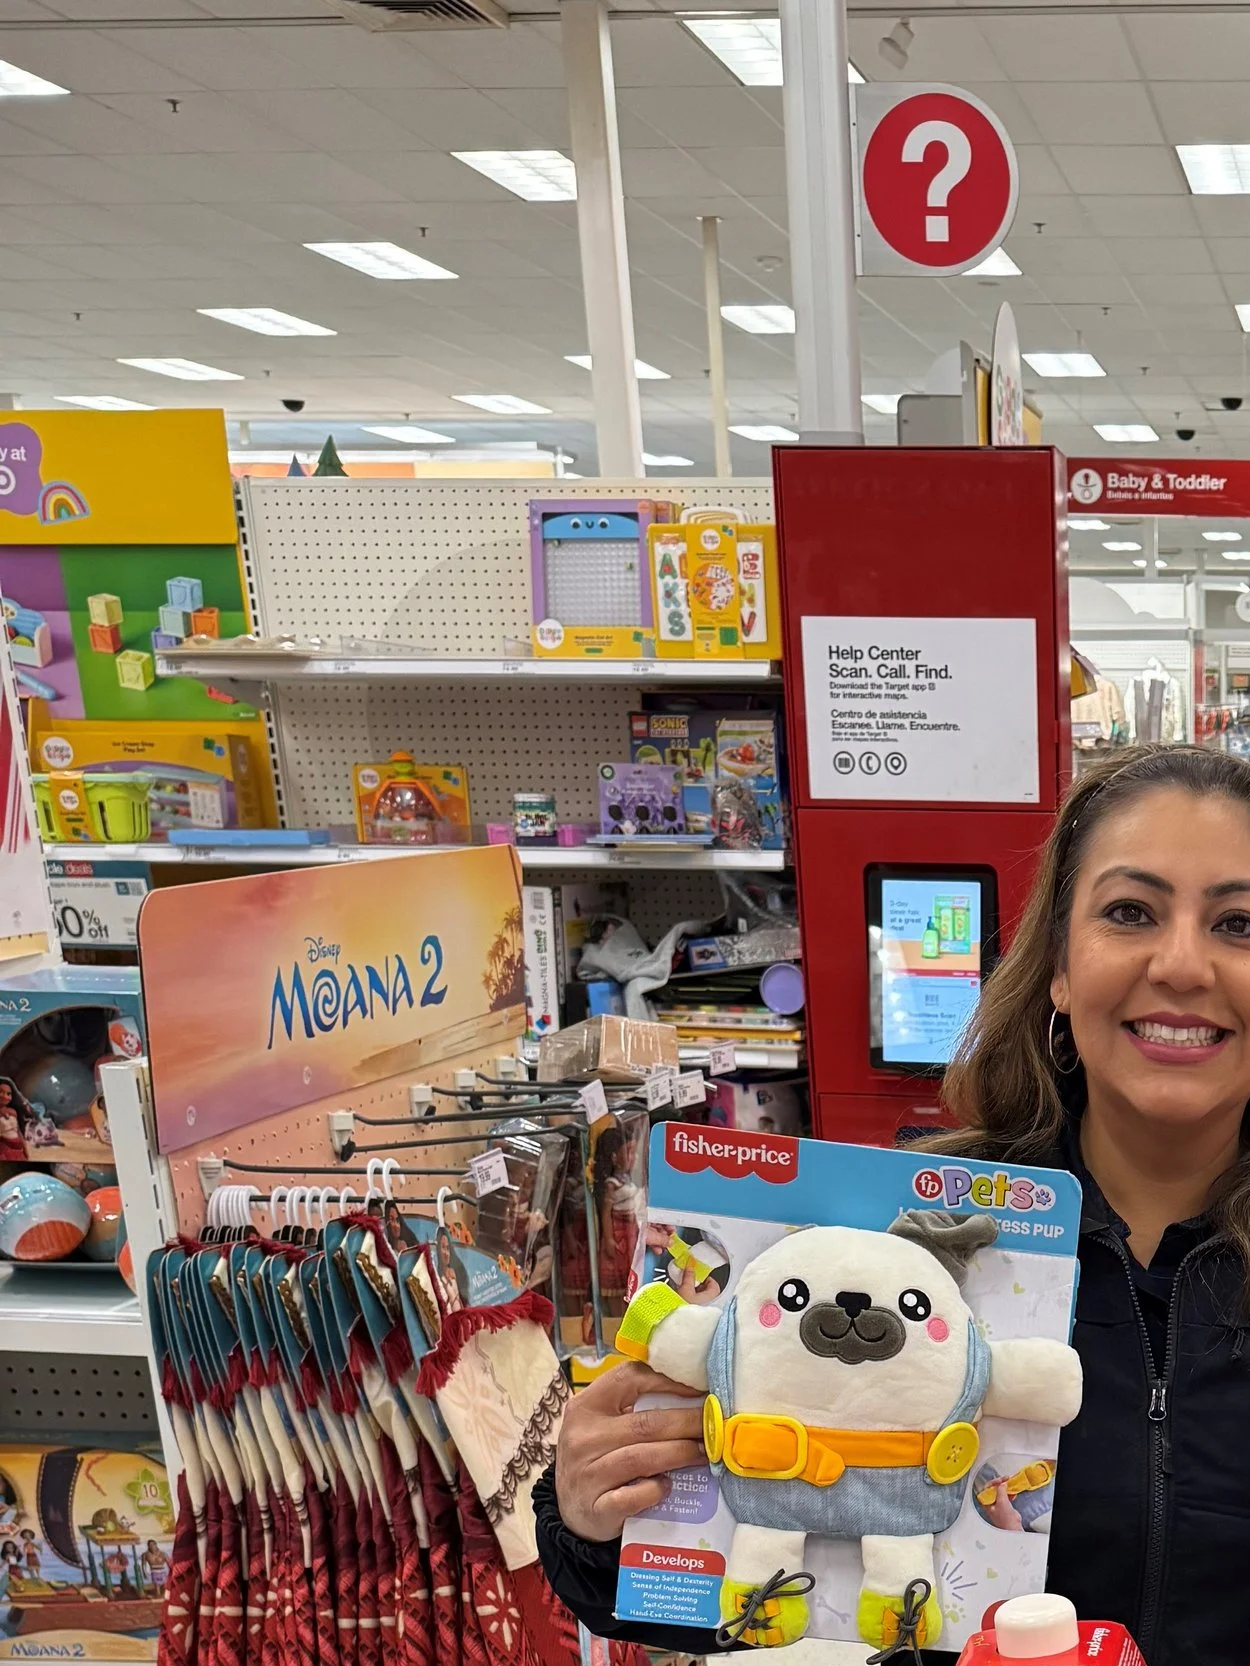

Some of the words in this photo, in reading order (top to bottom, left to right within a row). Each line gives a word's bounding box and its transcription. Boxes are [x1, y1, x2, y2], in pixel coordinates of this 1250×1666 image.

[11, 446, 27, 462] at
[1107, 472, 1148, 491] Baby
[1151, 473, 1164, 489] &
[1166, 474, 1228, 491] Toddler
[828, 645, 864, 663] Help
[868, 645, 922, 661] Center
[829, 664, 873, 679] Scan.
[877, 664, 911, 679] Call.
[915, 665, 953, 680] Find.
[829, 681, 869, 690] Download
[870, 682, 883, 690] the
[885, 682, 910, 692] Target
[911, 684, 927, 692] app
[829, 691, 841, 699] for
[842, 691, 882, 700] interactive
[884, 693, 909, 701] maps.
[831, 709, 863, 719] Centro
[865, 710, 878, 719] de
[879, 711, 928, 720] asistencia
[650, 717, 688, 729] SONIC
[831, 720, 874, 730] Escanee.
[876, 721, 907, 731] Llame.
[909, 721, 961, 731] Encuentre.
[56, 905, 101, 938] 0%
[88, 925, 109, 939] off
[304, 936, 342, 965] Disney
[267, 953, 415, 1050] MOANA
[419, 934, 448, 1008] 2
[19, 997, 32, 1013] 2
[672, 1130, 794, 1166] fisher-price
[942, 1167, 1036, 1212] Pets
[994, 1218, 1031, 1235] ress
[142, 1483, 158, 1498] 10
[641, 1549, 706, 1571] Develops
[630, 1571, 661, 1583] Dressing
[661, 1573, 676, 1583] Self
[683, 1576, 714, 1588] Dexterity
[631, 1581, 653, 1590] Sense
[654, 1583, 663, 1591] of
[662, 1584, 711, 1596] Independence
[642, 1591, 672, 1602] Problem
[673, 1594, 699, 1605] Solving
[664, 1611, 709, 1623] Coordination
[10, 1643, 71, 1658] MOANA
[73, 1643, 86, 1658] 2
